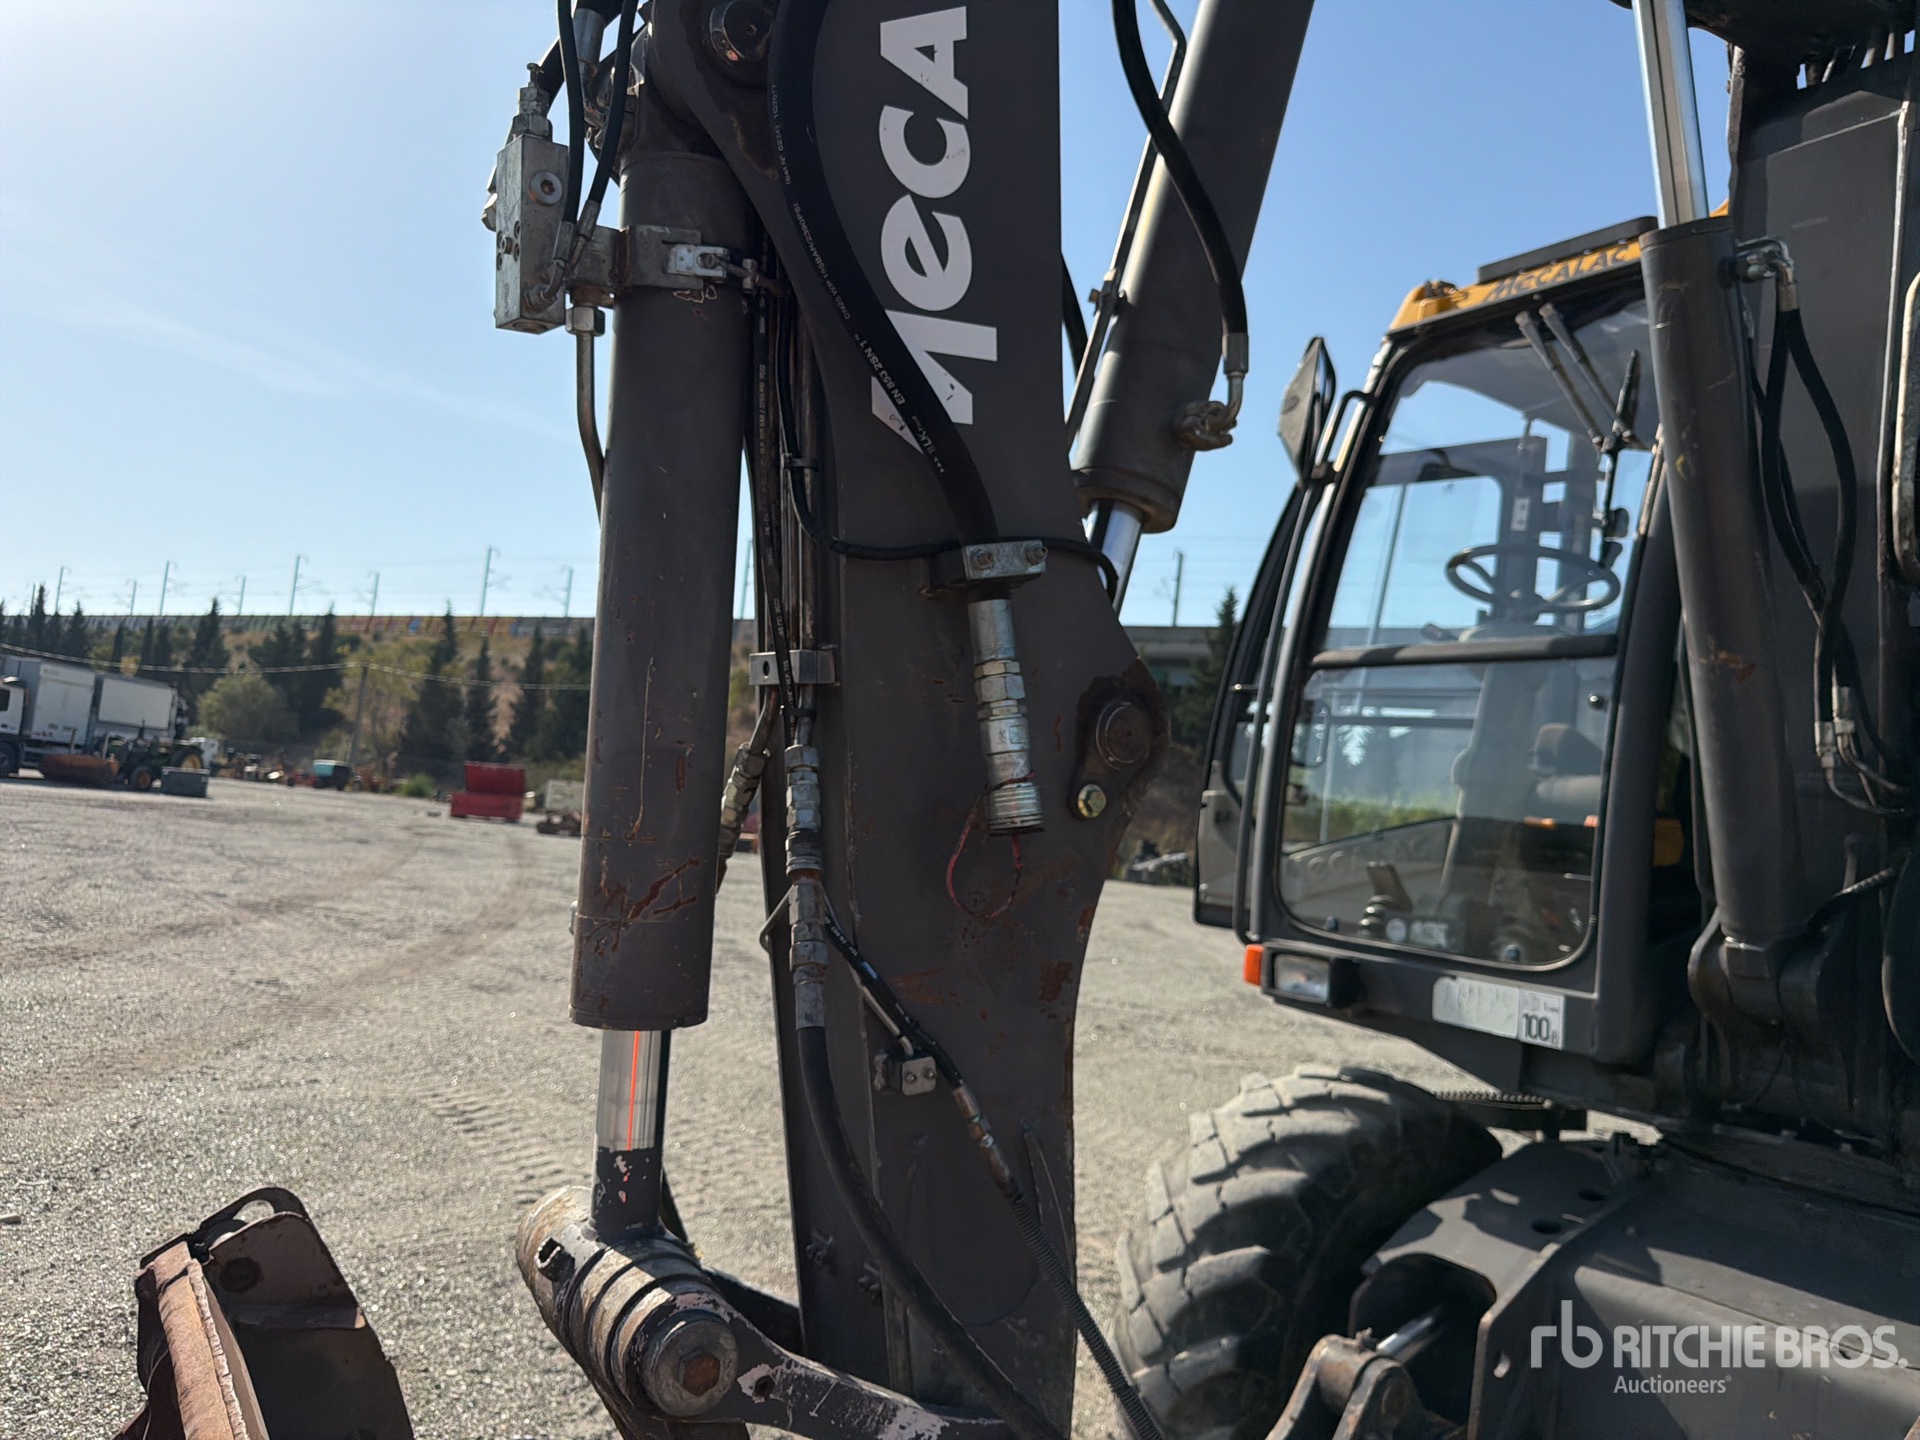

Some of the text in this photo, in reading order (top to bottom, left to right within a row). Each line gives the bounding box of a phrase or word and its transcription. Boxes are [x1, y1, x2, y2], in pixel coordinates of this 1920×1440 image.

[864, 347, 884, 371] 2SN
[879, 369, 897, 390] 853
[891, 386, 906, 405] EN
[1522, 1013, 1550, 1041] 100
